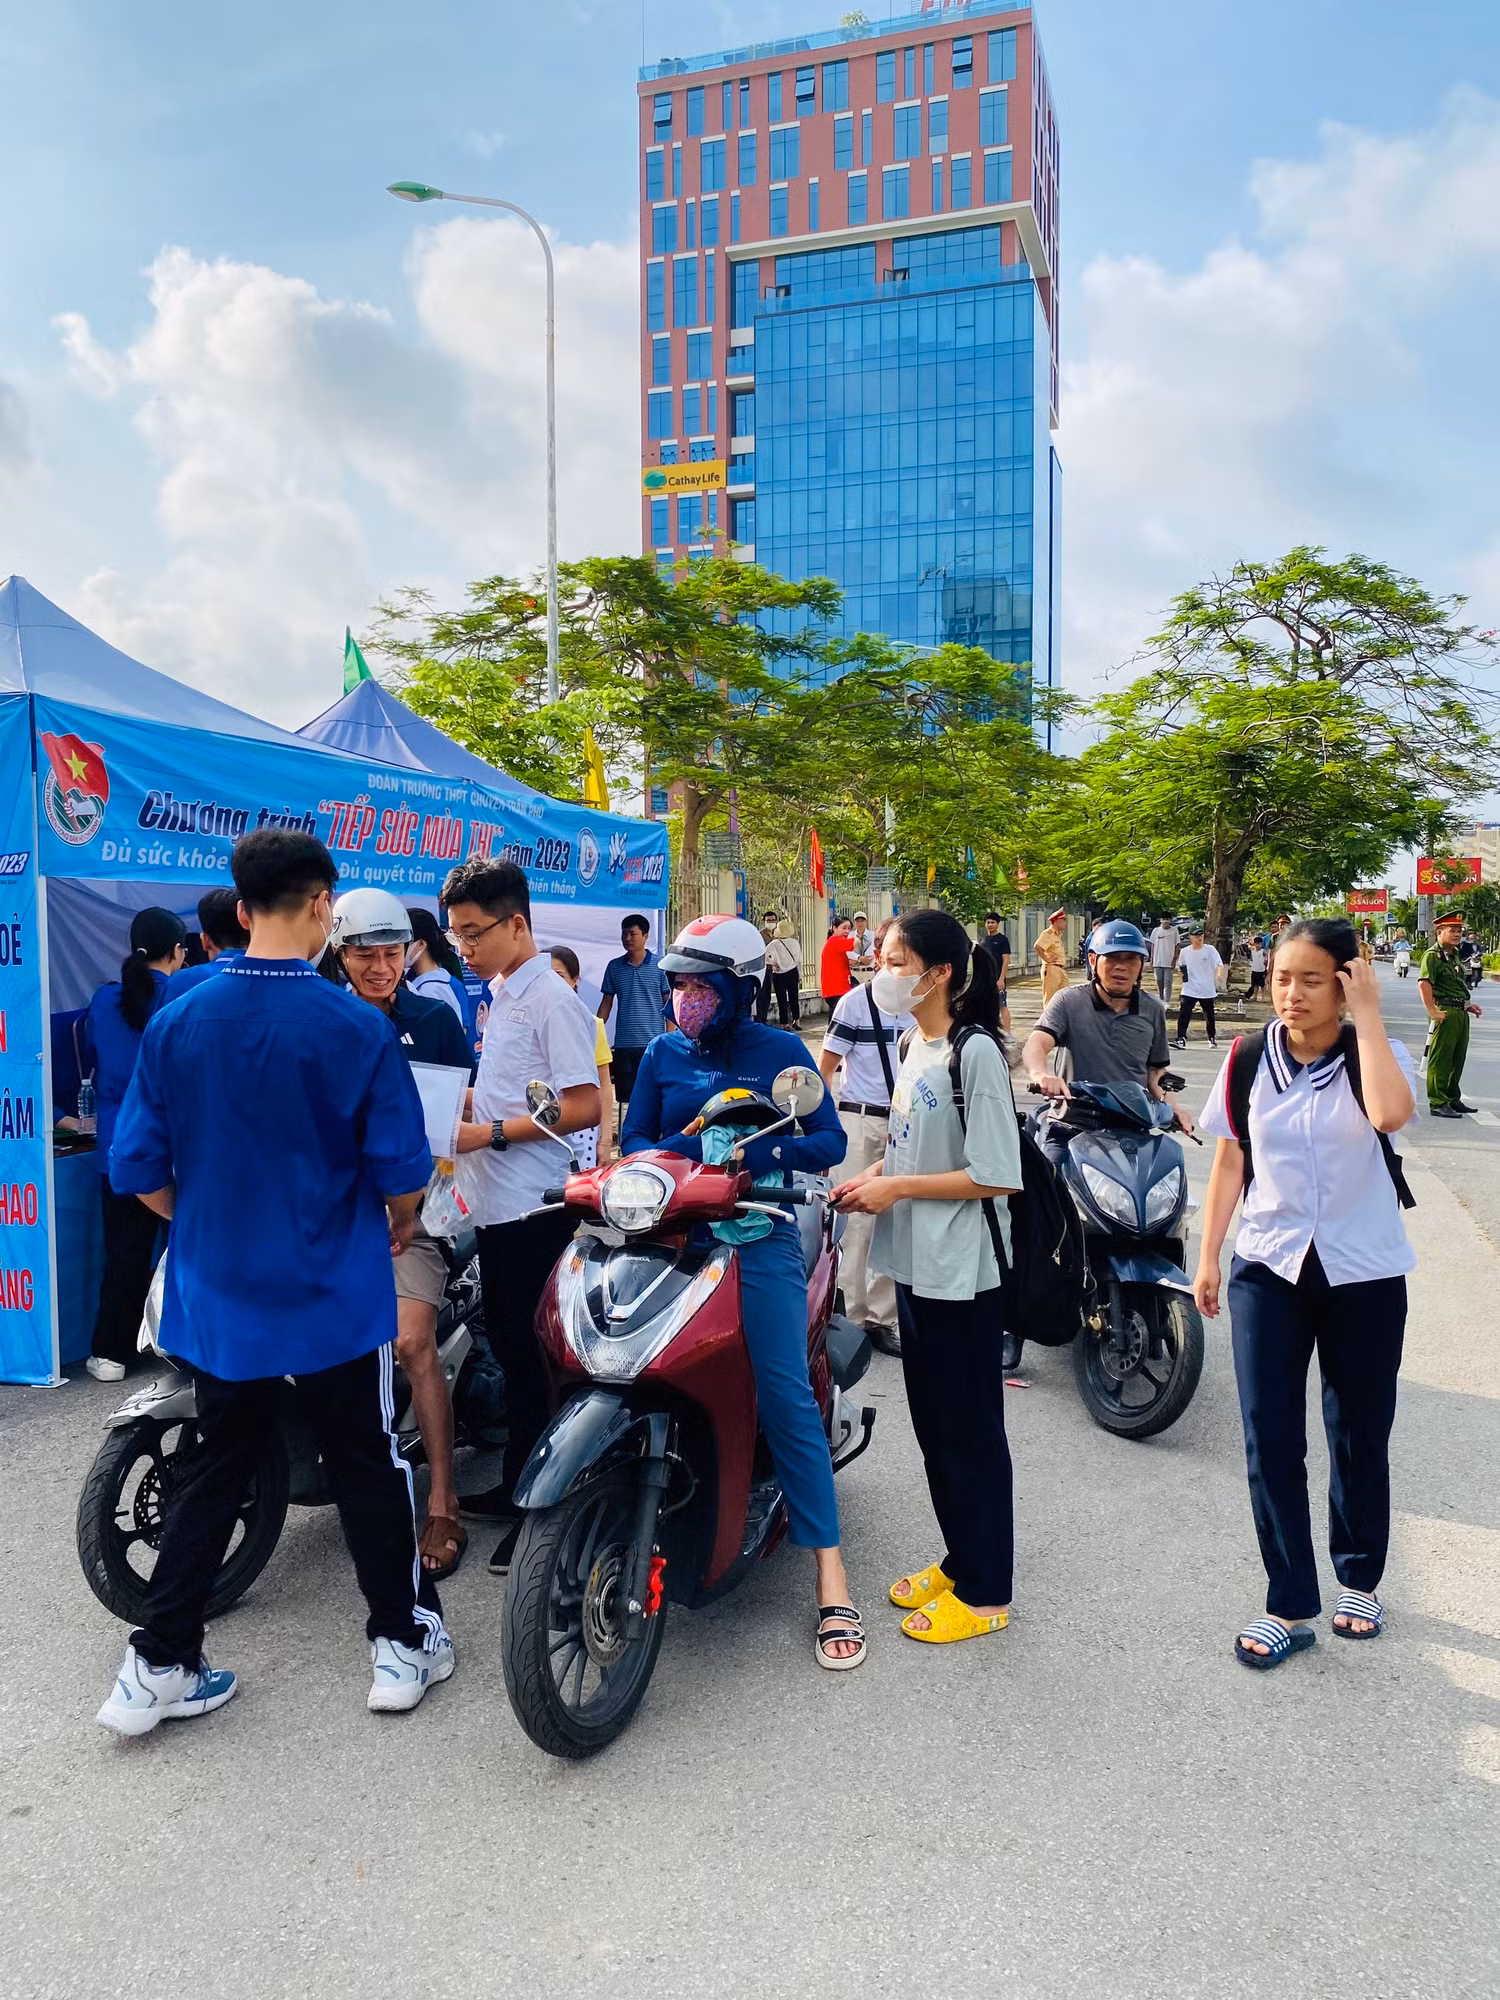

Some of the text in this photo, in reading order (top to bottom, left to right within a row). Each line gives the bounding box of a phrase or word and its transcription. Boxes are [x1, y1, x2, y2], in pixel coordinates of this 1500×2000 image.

[668, 472, 720, 486] Cathay Life
[367, 773, 398, 793] ĐOÀN
[444, 787, 468, 804] THPT
[138, 790, 250, 846] Chương
[376, 801, 419, 856] SỨC
[419, 808, 463, 861] MÙA
[503, 839, 533, 868] năm
[534, 836, 570, 873] 2023
[0, 852, 28, 874] 023
[101, 838, 131, 863] Đủ
[137, 840, 172, 867] sức
[177, 846, 228, 870] khỏe
[338, 859, 360, 880] Đủ
[364, 864, 405, 886] quyết
[408, 867, 435, 884] tâm
[528, 876, 549, 893] hiến
[551, 878, 576, 899] thắng
[642, 854, 664, 881] 2023
[0, 1087, 35, 1140] ÂM
[834, 1608, 858, 1619] CHANEL
